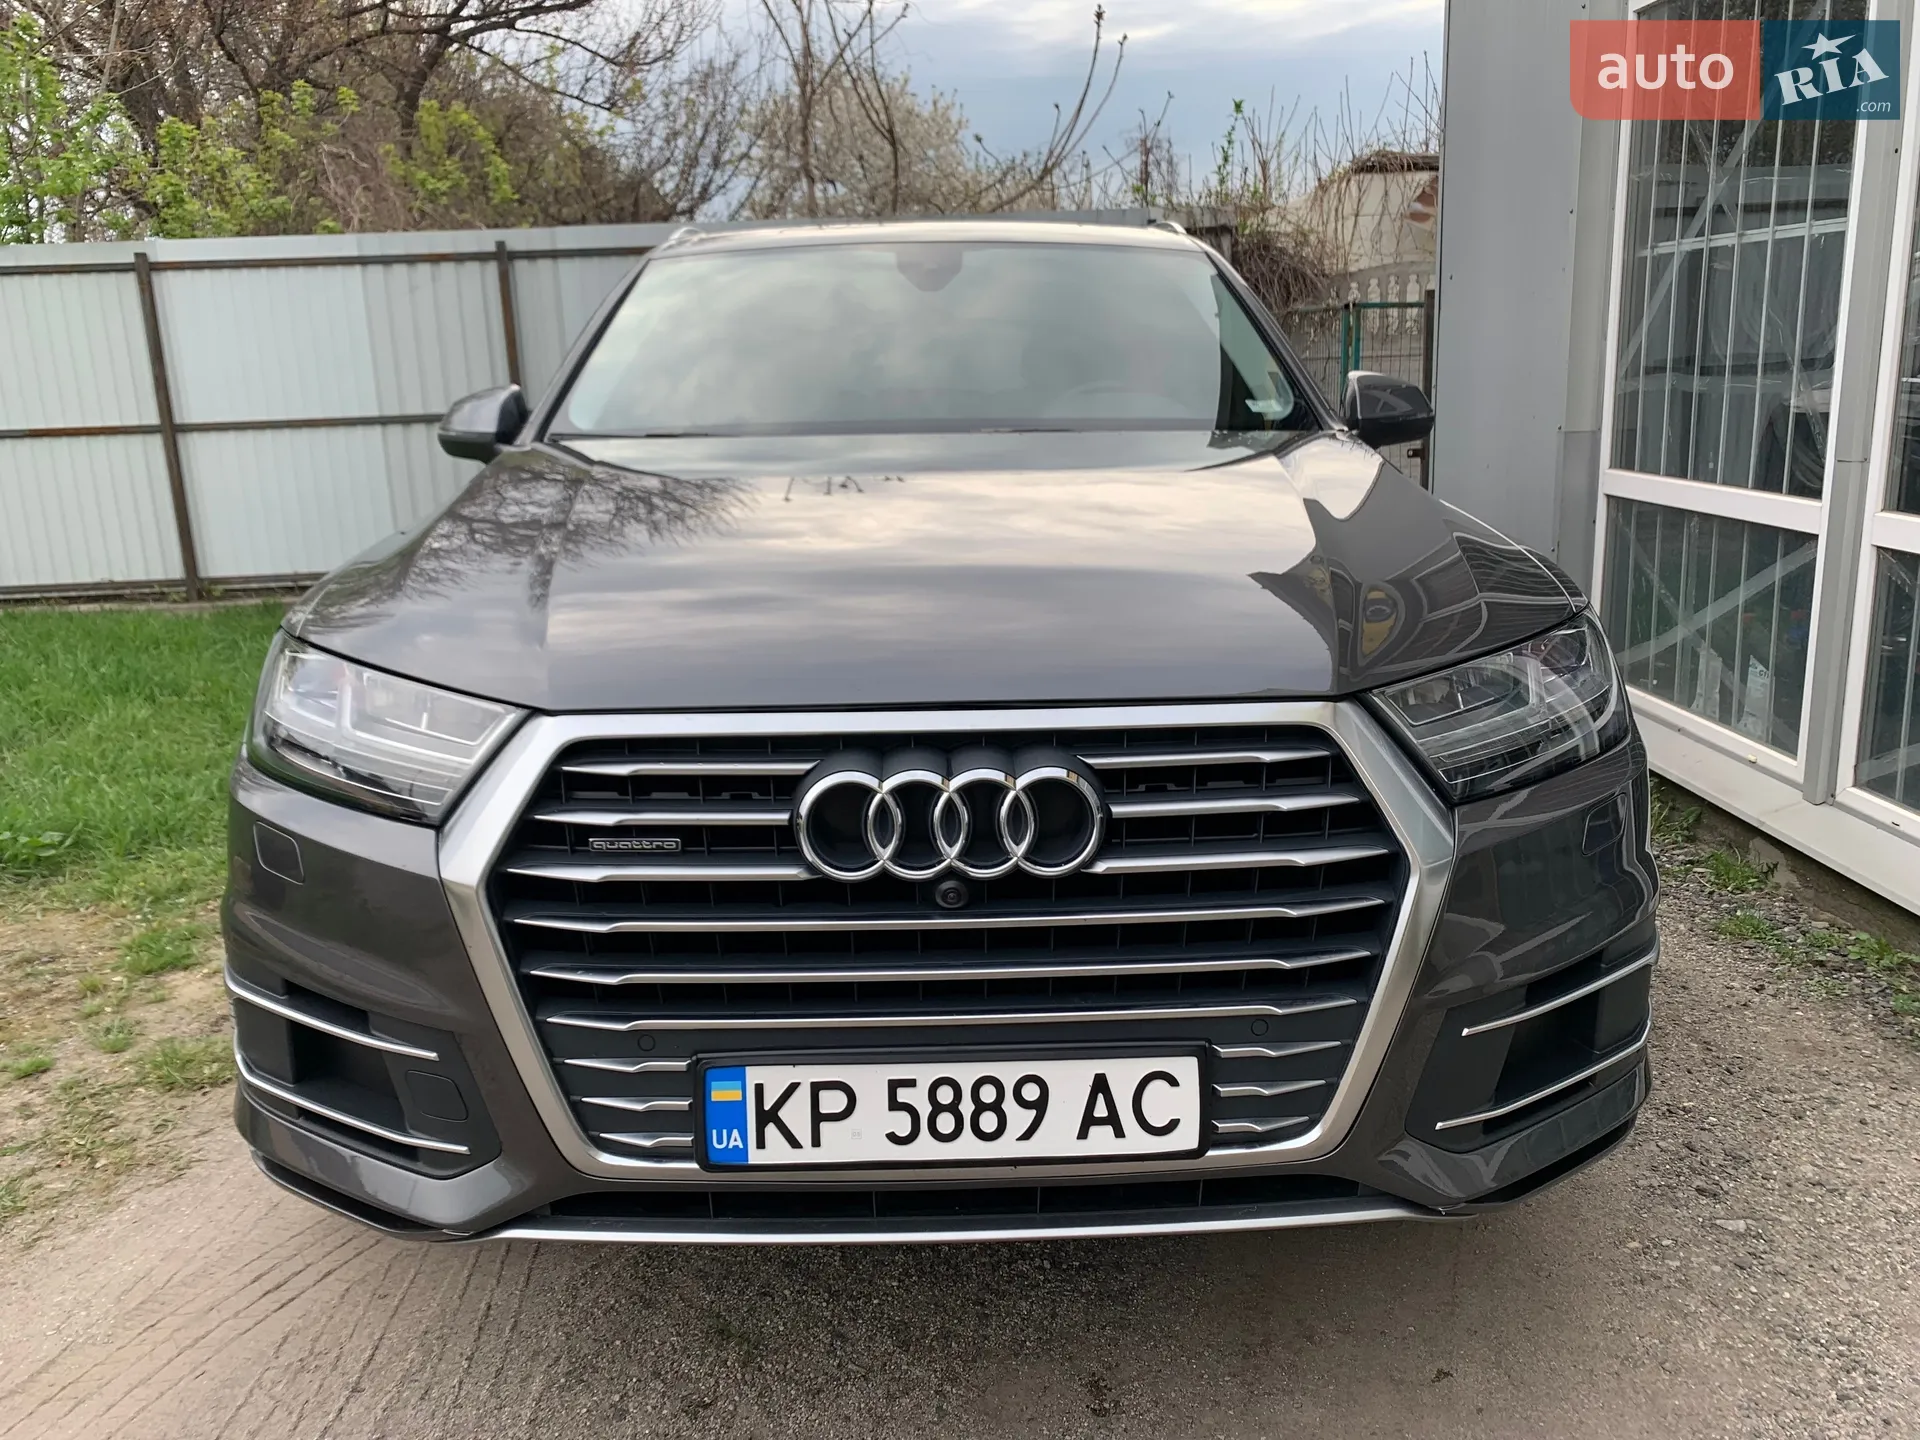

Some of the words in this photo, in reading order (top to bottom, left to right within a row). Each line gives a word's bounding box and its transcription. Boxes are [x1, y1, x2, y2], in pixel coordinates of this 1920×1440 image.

[593, 841, 677, 851] quattro
[754, 1080, 857, 1149] KP
[885, 1074, 1050, 1146] 5889
[1076, 1070, 1181, 1141] AC
[712, 1129, 744, 1149] UA
